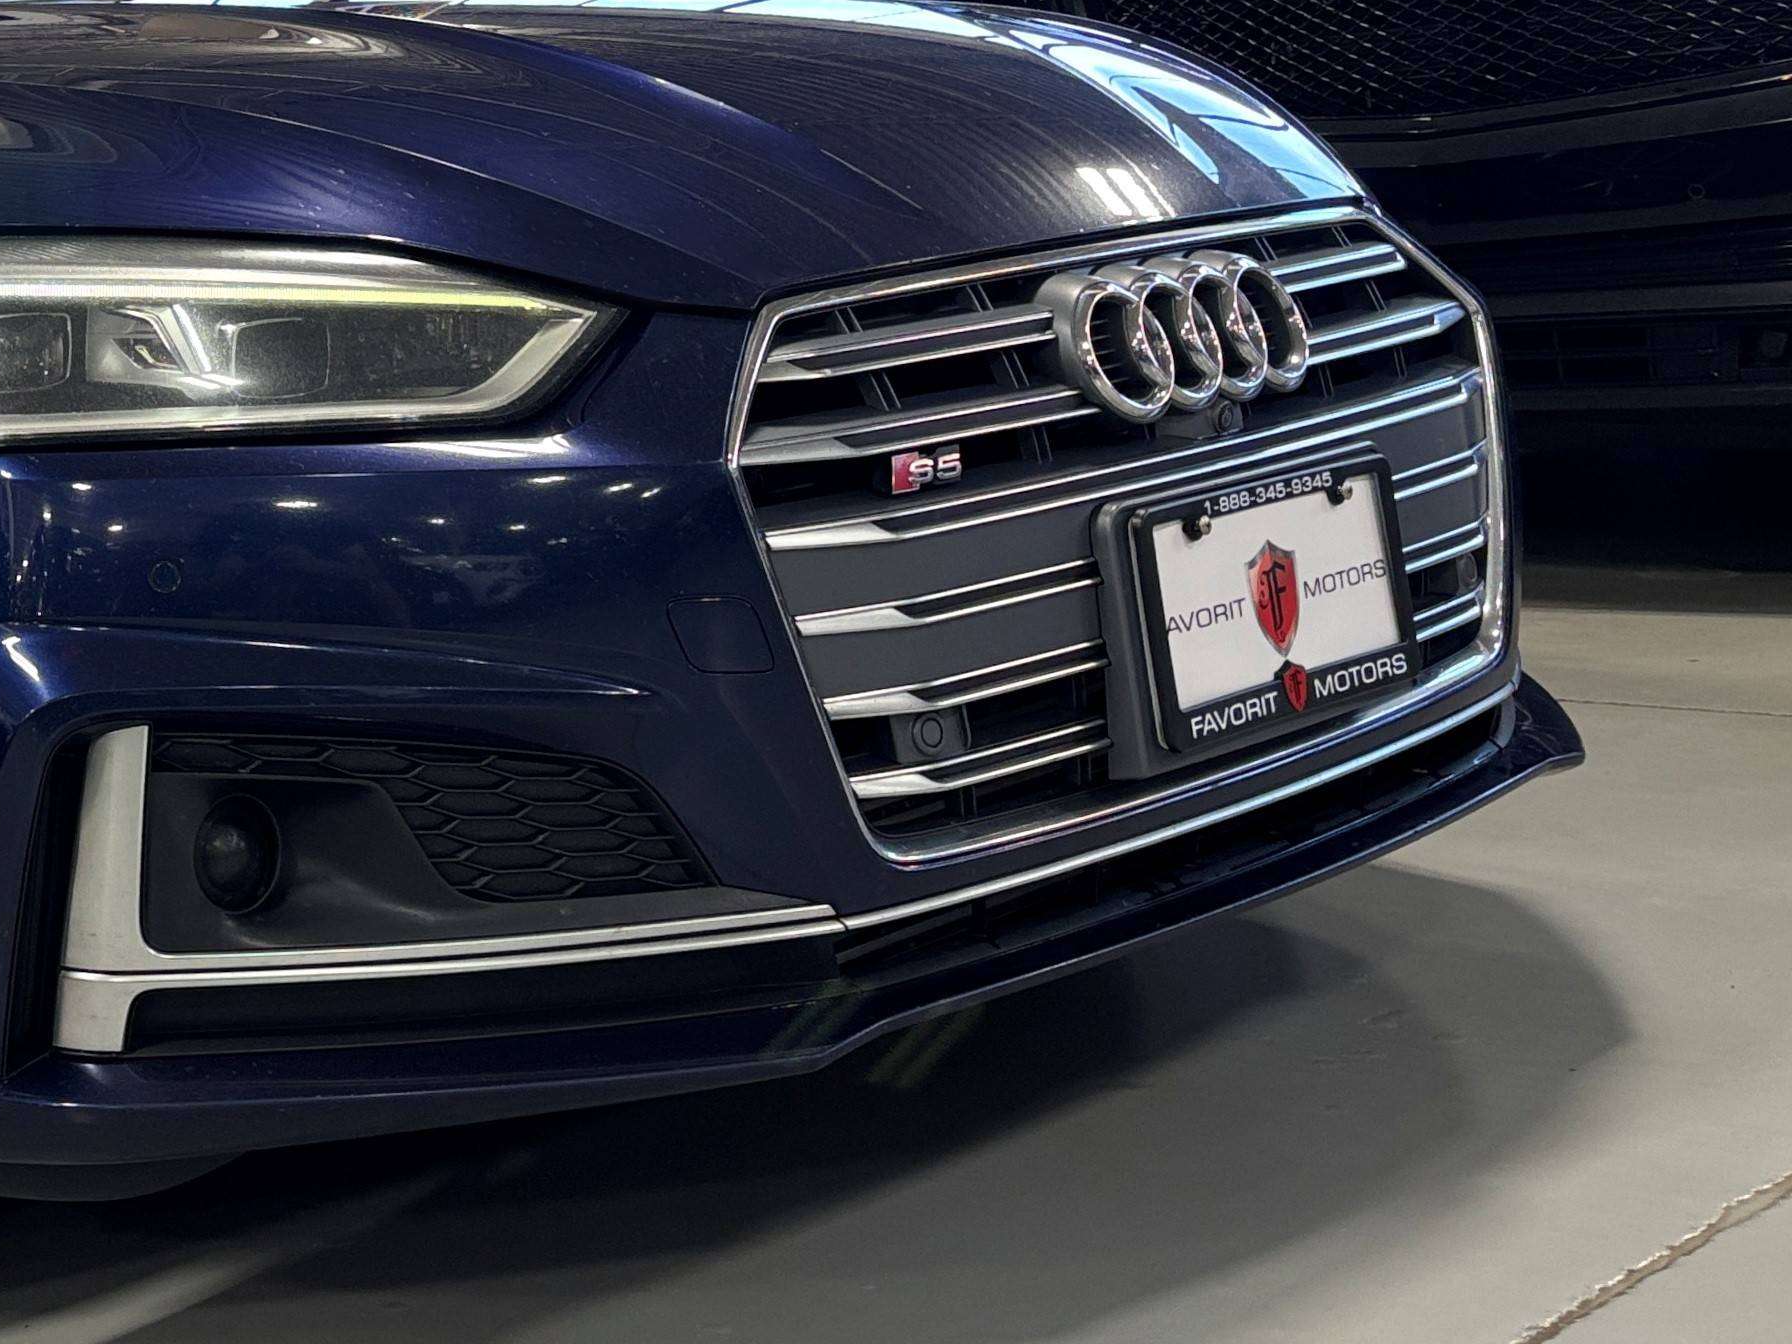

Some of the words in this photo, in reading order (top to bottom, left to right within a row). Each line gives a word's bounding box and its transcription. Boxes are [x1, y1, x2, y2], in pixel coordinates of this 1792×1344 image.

[908, 452, 962, 484] S5
[1203, 471, 1332, 515] 1-888-345-9345
[1166, 597, 1246, 633] AVORIT
[1303, 558, 1387, 599] MOTORS
[1190, 691, 1279, 740] FAVORIT
[1313, 653, 1408, 699] MOTORS
